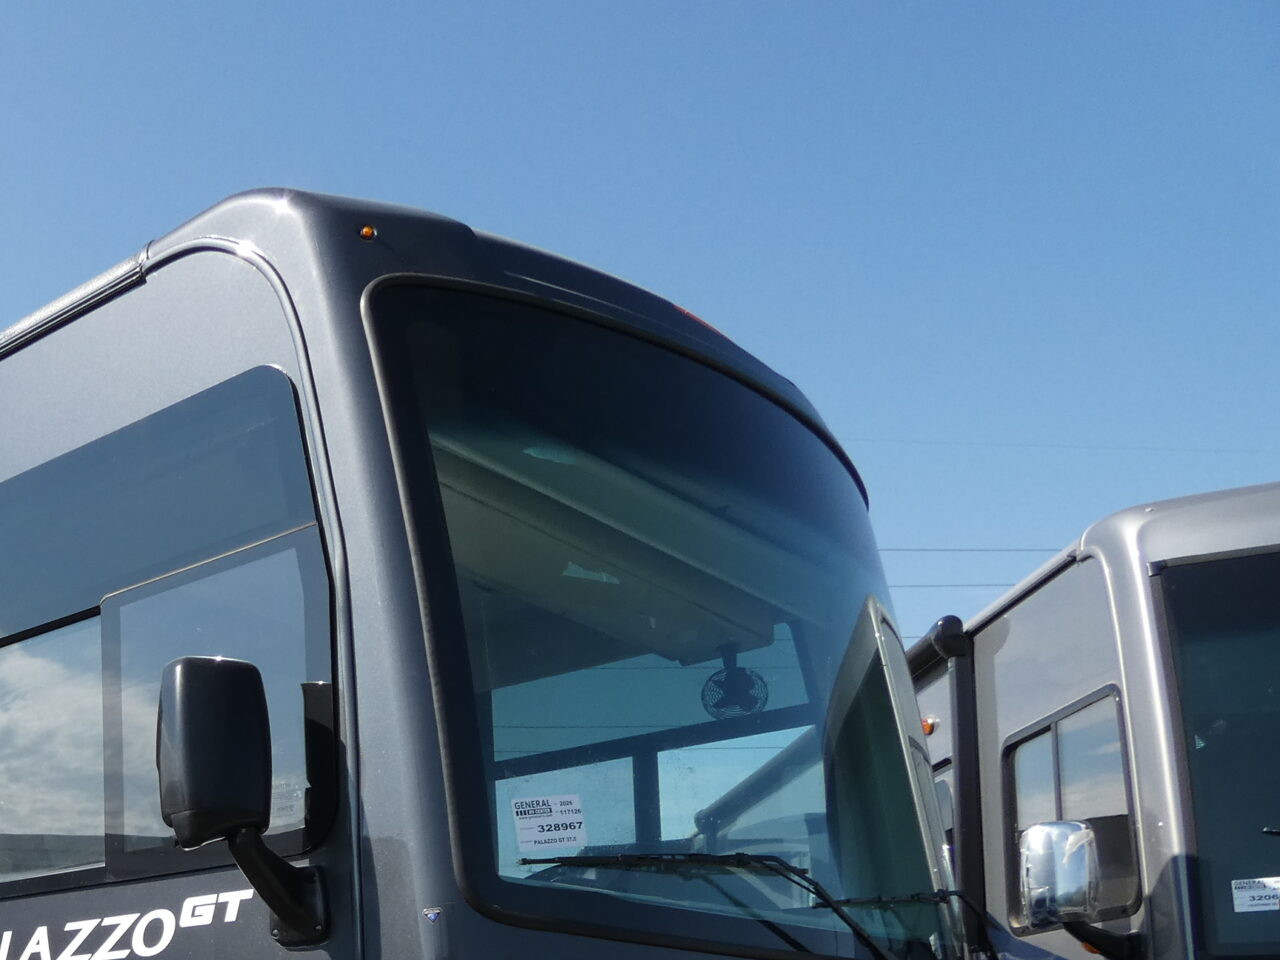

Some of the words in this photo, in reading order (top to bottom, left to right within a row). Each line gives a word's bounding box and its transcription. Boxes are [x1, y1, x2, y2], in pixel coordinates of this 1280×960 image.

[514, 799, 552, 810] GENERAL
[538, 822, 583, 833] 328967
[179, 888, 254, 928] GT
